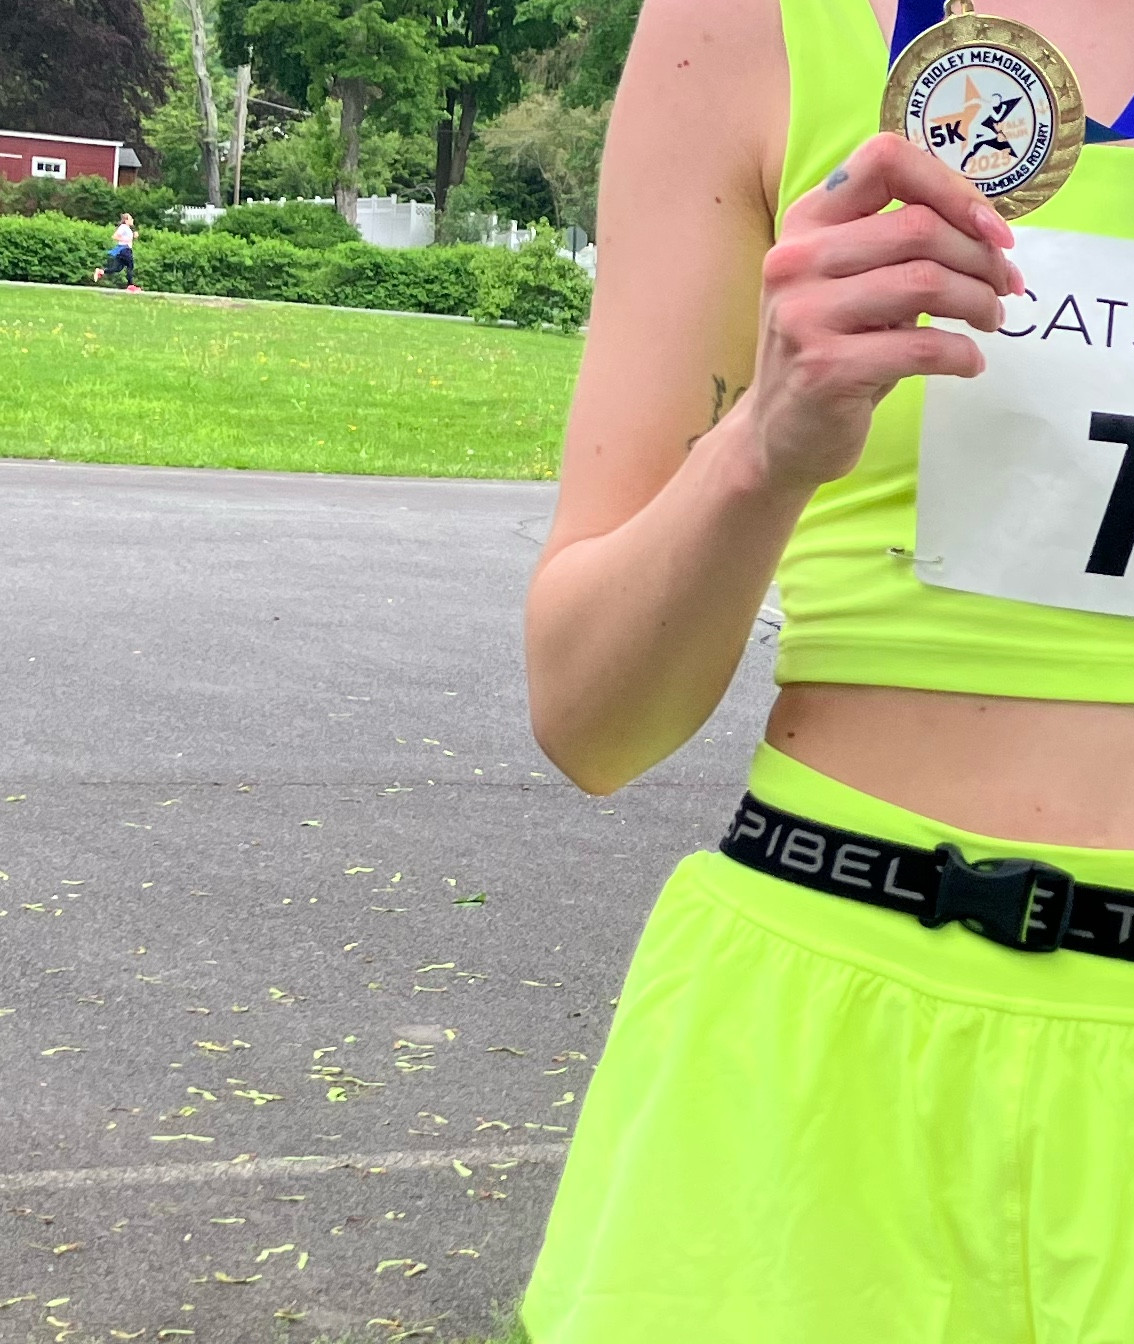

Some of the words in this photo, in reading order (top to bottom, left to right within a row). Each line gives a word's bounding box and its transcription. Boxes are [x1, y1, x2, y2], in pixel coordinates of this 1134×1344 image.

[910, 89, 926, 118] ART
[921, 52, 965, 89] RIDLEY
[970, 50, 1037, 91] MEMORIAL
[930, 120, 967, 148] 5K
[968, 151, 1012, 175] 2025
[975, 164, 1030, 193] TAMORAS
[1027, 122, 1049, 166] ROTARY
[725, 808, 943, 902] PIBEL
